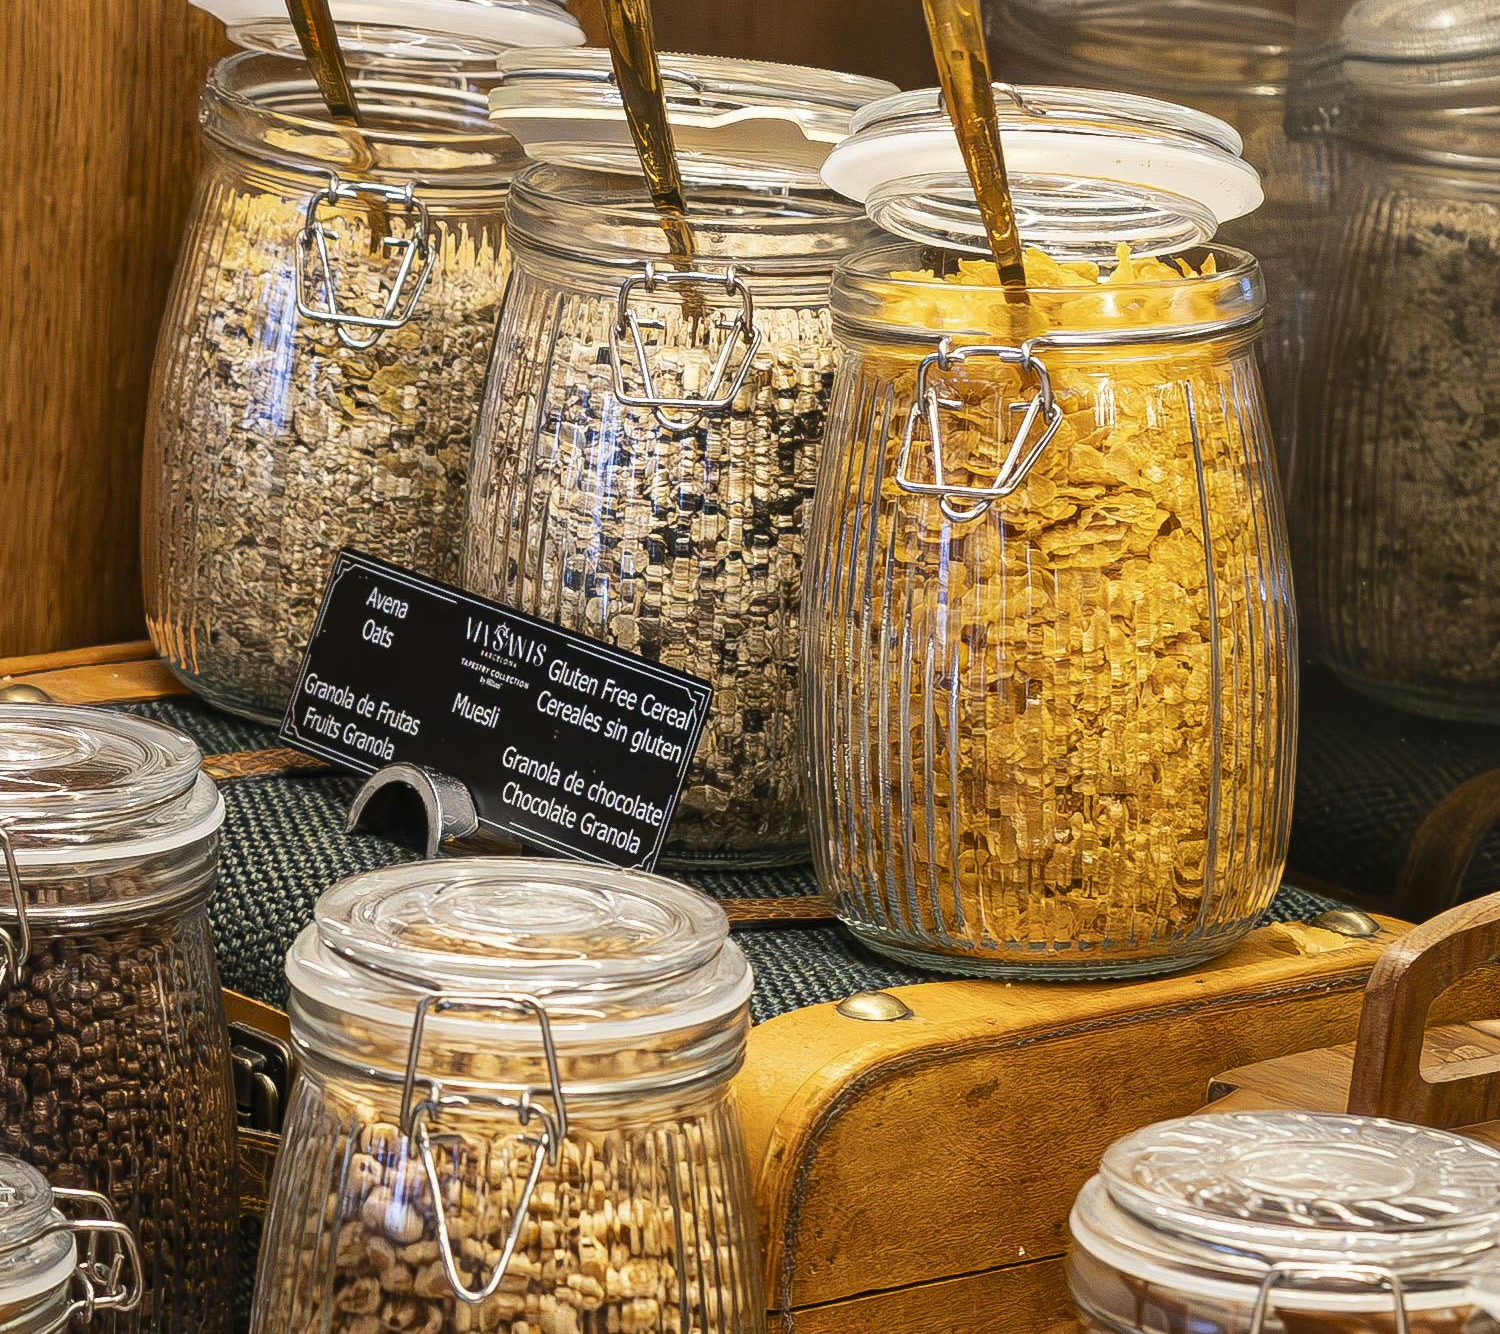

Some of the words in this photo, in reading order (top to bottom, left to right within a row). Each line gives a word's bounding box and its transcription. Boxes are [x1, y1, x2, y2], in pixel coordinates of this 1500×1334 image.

[365, 586, 409, 619] Avena
[362, 618, 395, 649] Oats
[480, 649, 517, 668] BARCELONA
[460, 657, 491, 674] TAPESTRY
[490, 669, 530, 690] COLLECTION
[548, 659, 599, 696] Gluten
[600, 678, 638, 711] Free
[640, 693, 693, 731] Cereal
[304, 672, 355, 710] Granola
[356, 693, 376, 718] de
[375, 700, 421, 736] Frutas
[451, 692, 501, 729] Muesli
[536, 690, 603, 733] Cereales
[603, 717, 628, 743] sin
[629, 727, 682, 764] gluten
[302, 706, 342, 739] Fruits
[342, 722, 395, 761] Granola
[502, 745, 561, 787] Granola
[563, 770, 585, 796] de
[587, 780, 663, 827] chocolate
[502, 781, 577, 829] Chocolate
[580, 812, 641, 855] Granola
